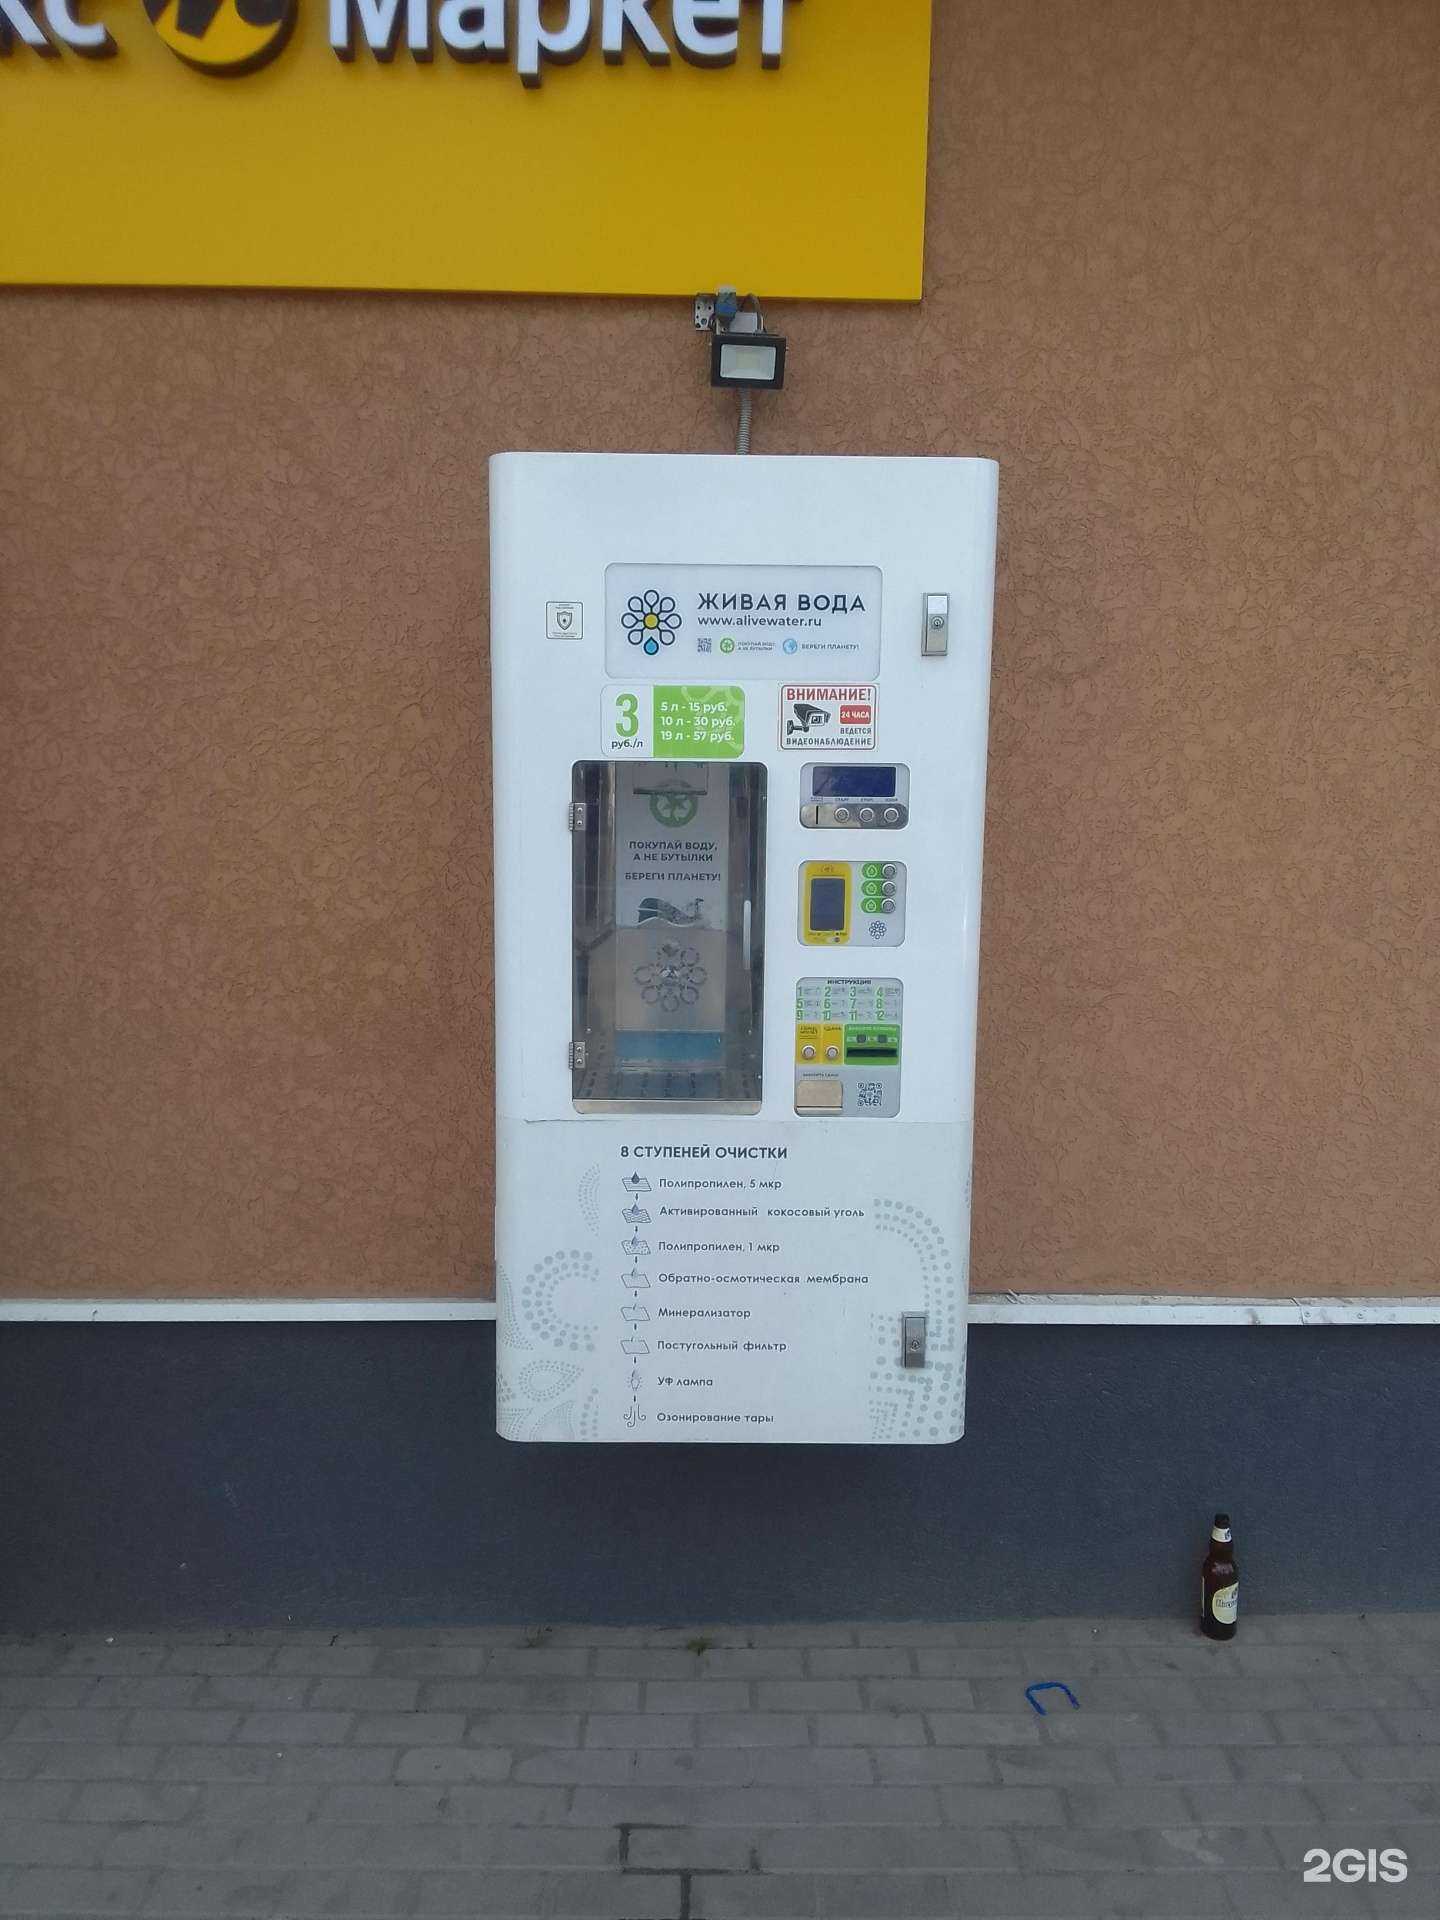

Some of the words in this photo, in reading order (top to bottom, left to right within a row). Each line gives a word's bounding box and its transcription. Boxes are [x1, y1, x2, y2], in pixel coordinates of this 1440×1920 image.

[698, 593, 787, 611] ЖИВАЯ
[798, 594, 866, 614] ВОДА
[698, 614, 822, 627] www.alivewater.ru
[786, 688, 871, 701] ВНИМАНИЕ!
[660, 702, 668, 711] 5
[670, 703, 679, 712] л
[688, 702, 700, 712] 15
[703, 702, 728, 713] руб.
[615, 693, 639, 737] 3
[660, 716, 673, 726] 10
[675, 718, 684, 726] л
[693, 716, 709, 726] 30
[711, 716, 736, 728] руб.
[660, 730, 673, 741] 19
[674, 732, 684, 741] л
[693, 731, 707, 741] 57
[710, 731, 735, 743] руб.
[840, 727, 872, 735] ВЕДЕТСЯ
[611, 738, 643, 750] руб./л
[786, 737, 872, 746] ВИДЕОНАБЛЮДЕНИЕ
[629, 840, 682, 850] ПОКУПАЙ
[685, 841, 718, 851] ВОДУ,
[633, 853, 641, 861] А
[643, 853, 658, 861] НЕ
[660, 853, 713, 862] БУТЫЛКИ
[625, 872, 665, 881] БЕРЕГИ
[667, 872, 721, 882] ПЛАНЕТУ!
[824, 986, 832, 998] 2
[849, 986, 857, 997] 3
[876, 987, 883, 997] 4
[796, 998, 803, 1009] 5
[823, 998, 831, 1009] 6
[849, 998, 856, 1009] 7
[876, 998, 883, 1009] 8
[875, 1010, 885, 1020] 12
[620, 1146, 629, 1158] 8
[634, 1144, 710, 1159] СТУПЕНЕЙ
[715, 1146, 788, 1159] ОЧИСТКИ
[659, 1179, 747, 1190] Полипропилен,
[749, 1179, 756, 1189] 5
[759, 1180, 782, 1190] мкр
[659, 1206, 758, 1217] Активированный
[767, 1207, 830, 1218] кокосовый
[834, 1208, 865, 1220] уголь
[658, 1241, 746, 1253] Полипропилен,
[757, 1243, 780, 1253] мкр
[658, 1273, 800, 1285] Обратно-осмотическая
[806, 1274, 869, 1284] мембрана
[658, 1307, 751, 1319] Минерализатор
[657, 1340, 738, 1352] Постугольный
[743, 1341, 787, 1353] фильтр
[657, 1376, 674, 1386] УФ
[676, 1377, 714, 1387] лампа
[656, 1412, 742, 1423] Озонирование
[745, 1413, 774, 1423] тары
